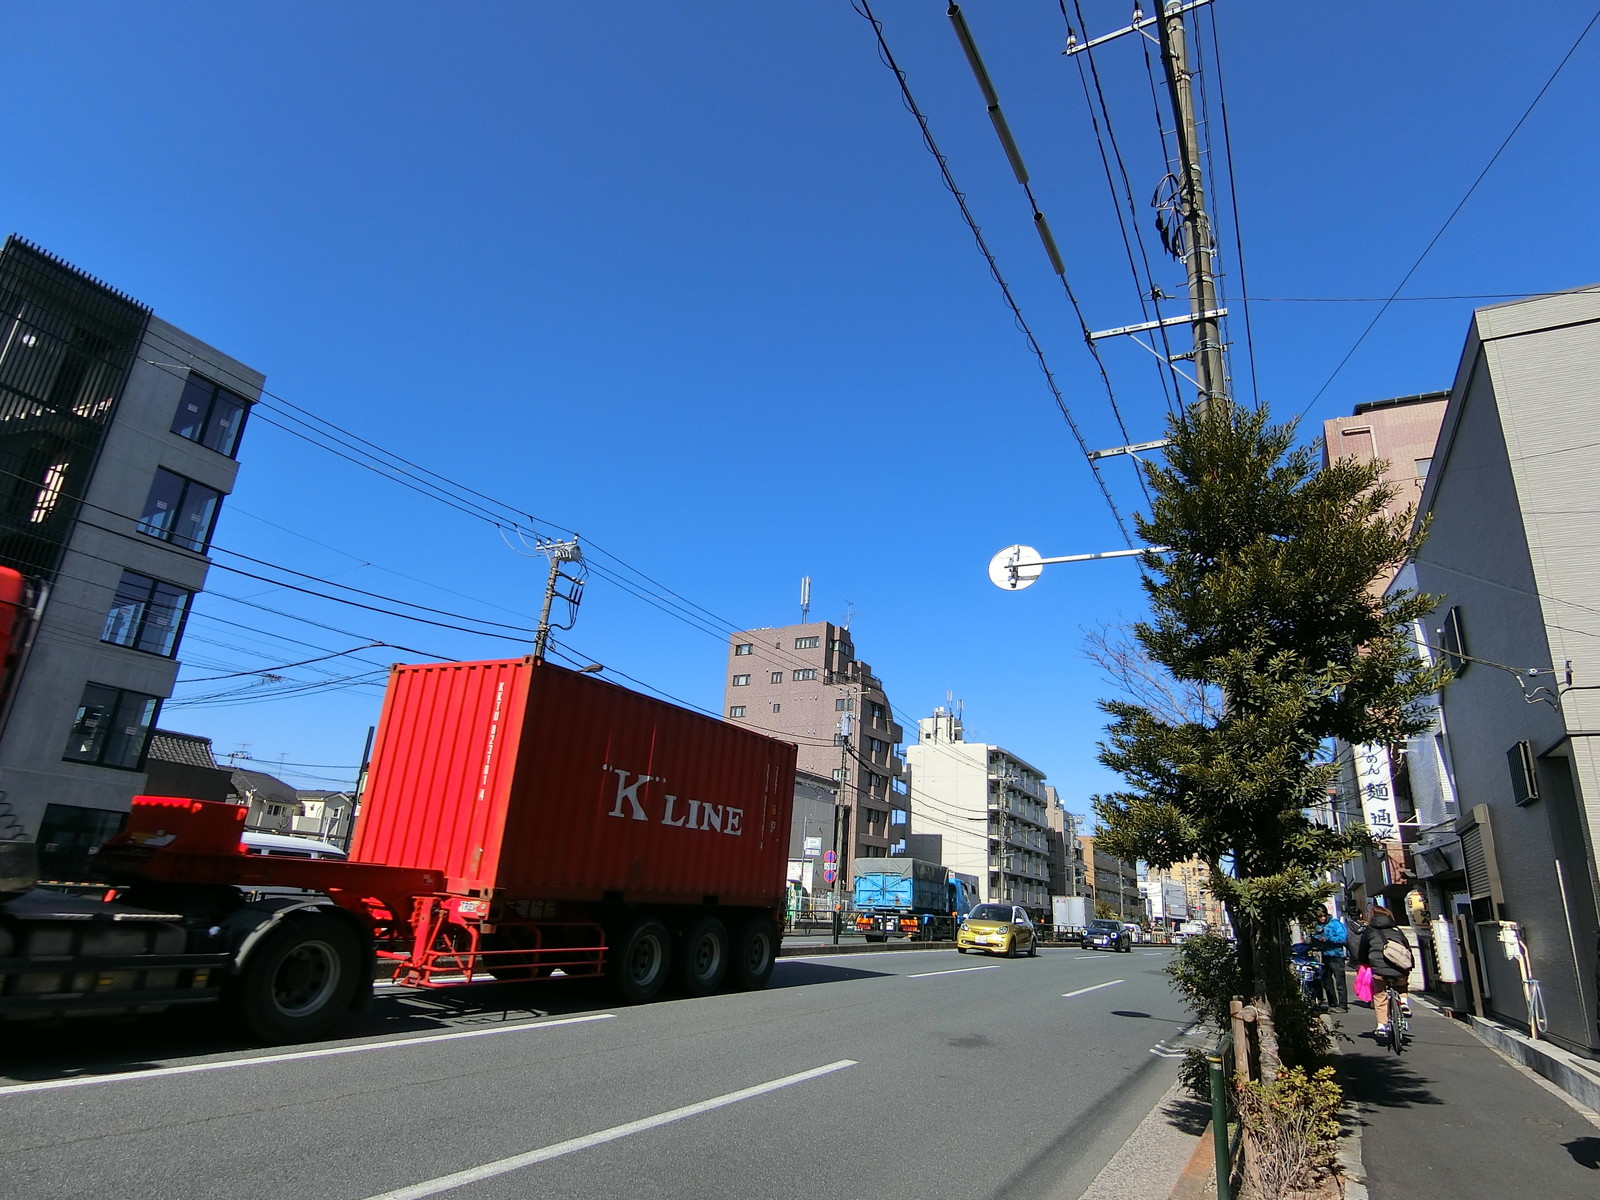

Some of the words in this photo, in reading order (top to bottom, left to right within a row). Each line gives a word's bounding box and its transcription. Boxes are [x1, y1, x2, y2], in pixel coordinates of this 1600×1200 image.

[493, 681, 505, 721] KKTU
[661, 794, 744, 836] LINE
[807, 839, 820, 849] P
